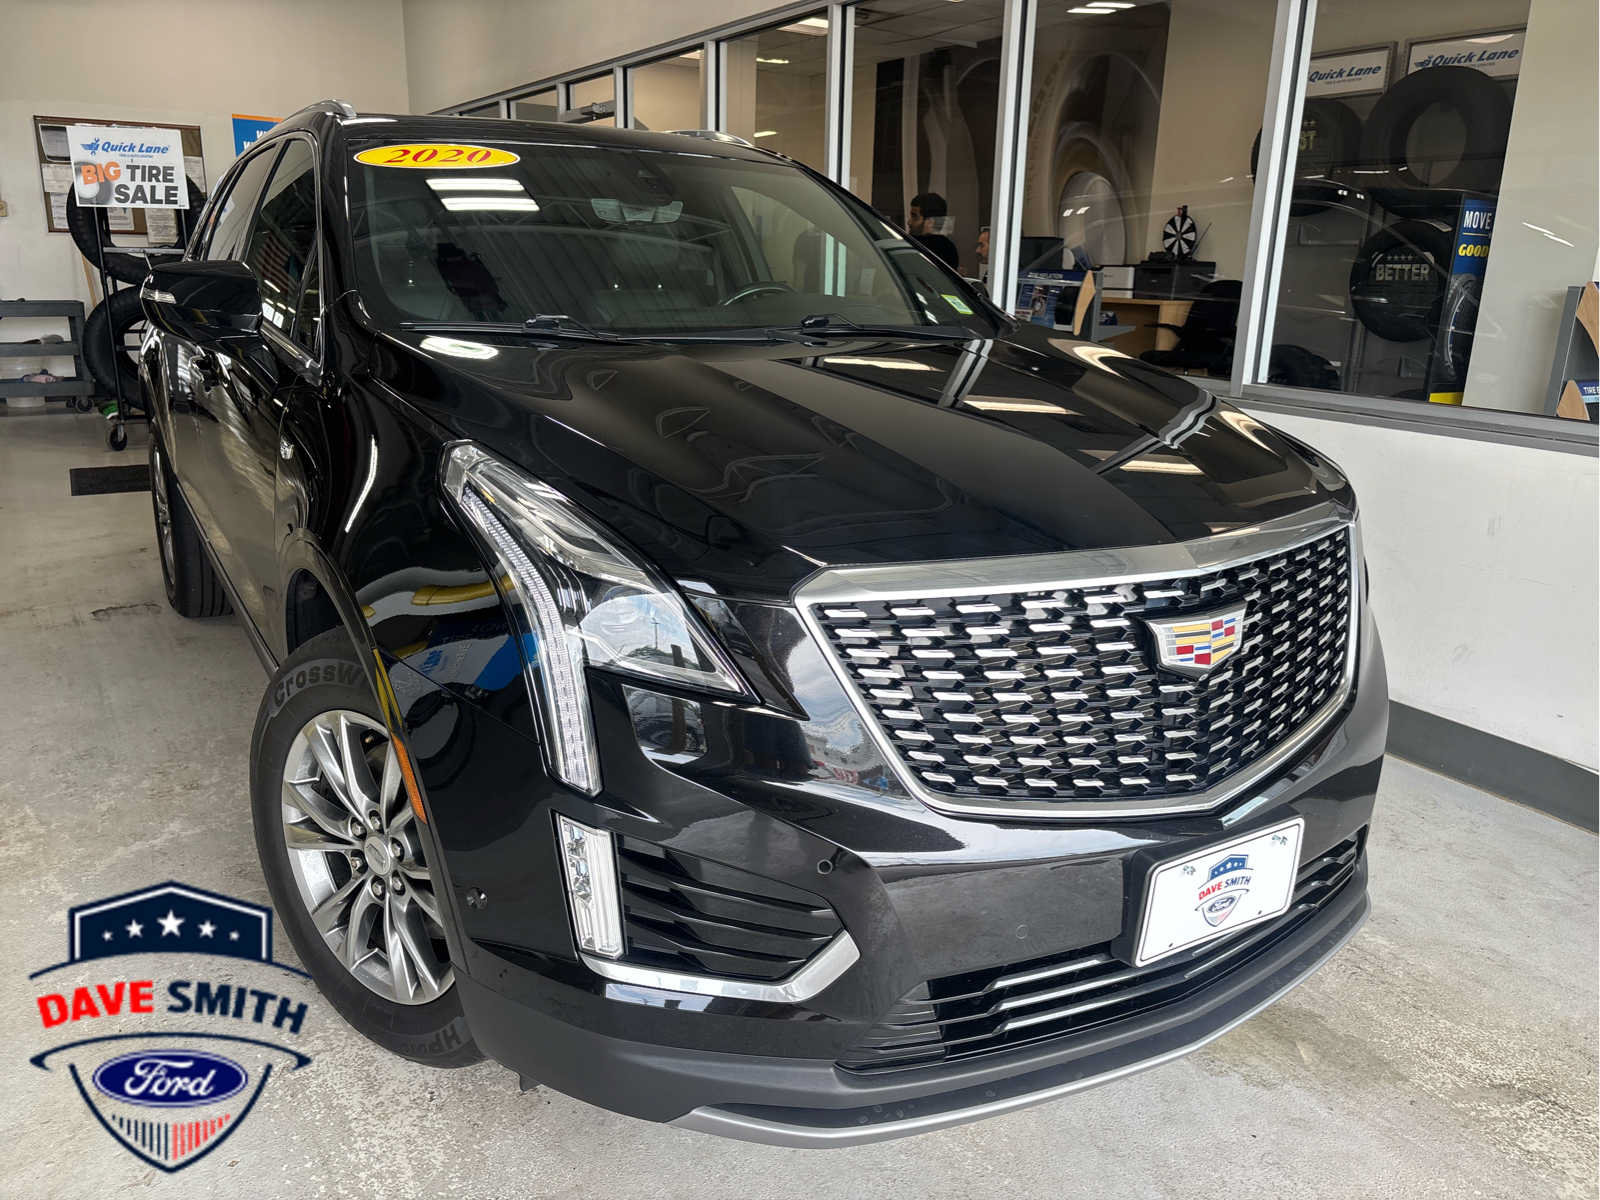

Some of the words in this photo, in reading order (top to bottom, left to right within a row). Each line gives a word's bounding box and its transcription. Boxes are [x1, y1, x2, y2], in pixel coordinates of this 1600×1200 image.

[1431, 49, 1475, 67] Quick
[1477, 49, 1519, 62] Lane
[1309, 68, 1345, 83] Quick
[1347, 65, 1382, 77] Lane
[101, 141, 135, 153] Quick
[138, 142, 169, 154] Lane
[384, 149, 491, 163] 2020
[80, 161, 121, 185] BIG
[126, 164, 175, 183] TIRE
[114, 184, 179, 205] SALE
[1463, 210, 1492, 230] MOVE
[1375, 263, 1430, 281] BETTER
[1198, 882, 1222, 900] DAVE
[1224, 876, 1251, 888] SMITH
